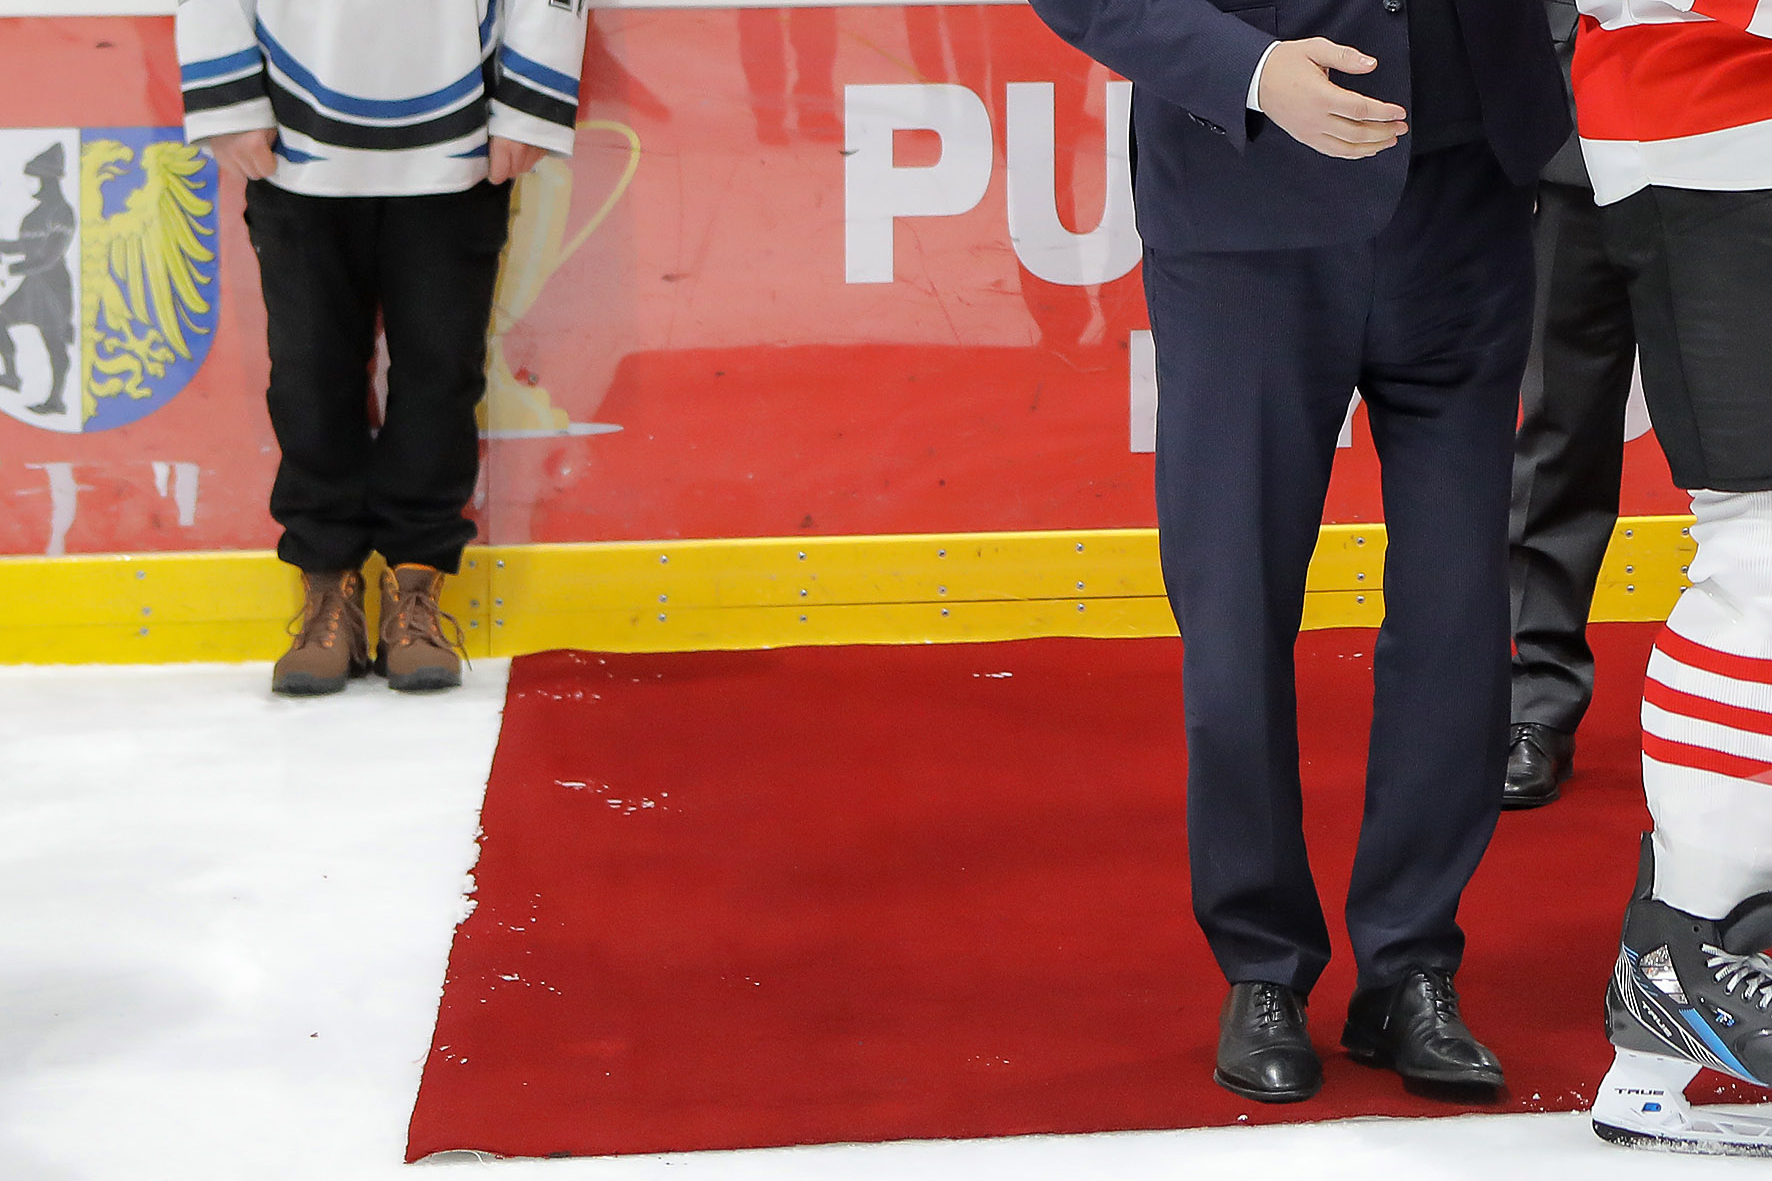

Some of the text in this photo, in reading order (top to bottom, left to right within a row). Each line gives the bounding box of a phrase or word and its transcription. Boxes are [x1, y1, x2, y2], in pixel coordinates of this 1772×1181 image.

[844, 81, 1144, 287] PU
[1640, 1000, 1674, 1039] TRUE
[1613, 1086, 1665, 1096] TRUE
